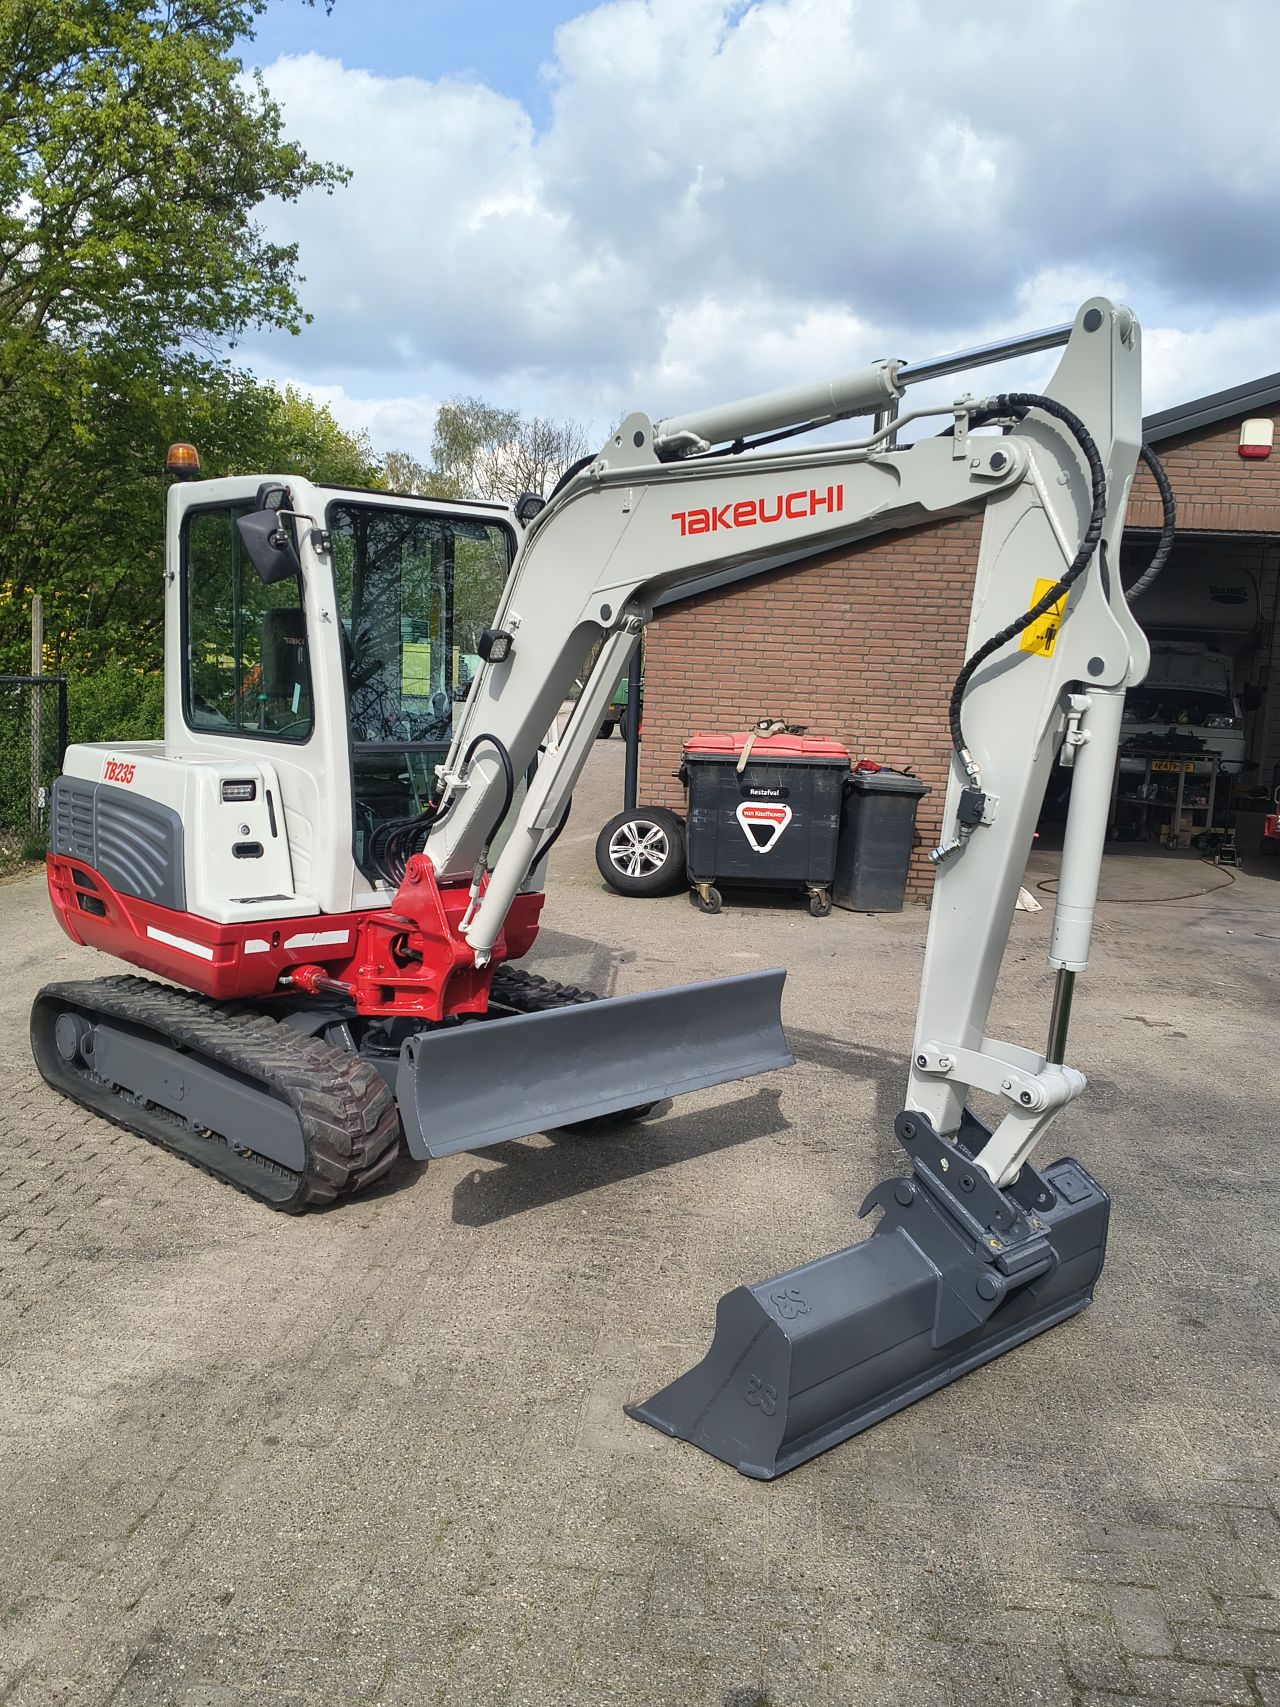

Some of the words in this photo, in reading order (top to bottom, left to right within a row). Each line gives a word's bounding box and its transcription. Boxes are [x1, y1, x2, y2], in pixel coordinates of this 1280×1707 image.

[671, 484, 844, 537] TAKEUCHI
[103, 760, 137, 785] TB235
[749, 788, 780, 796] Restafval
